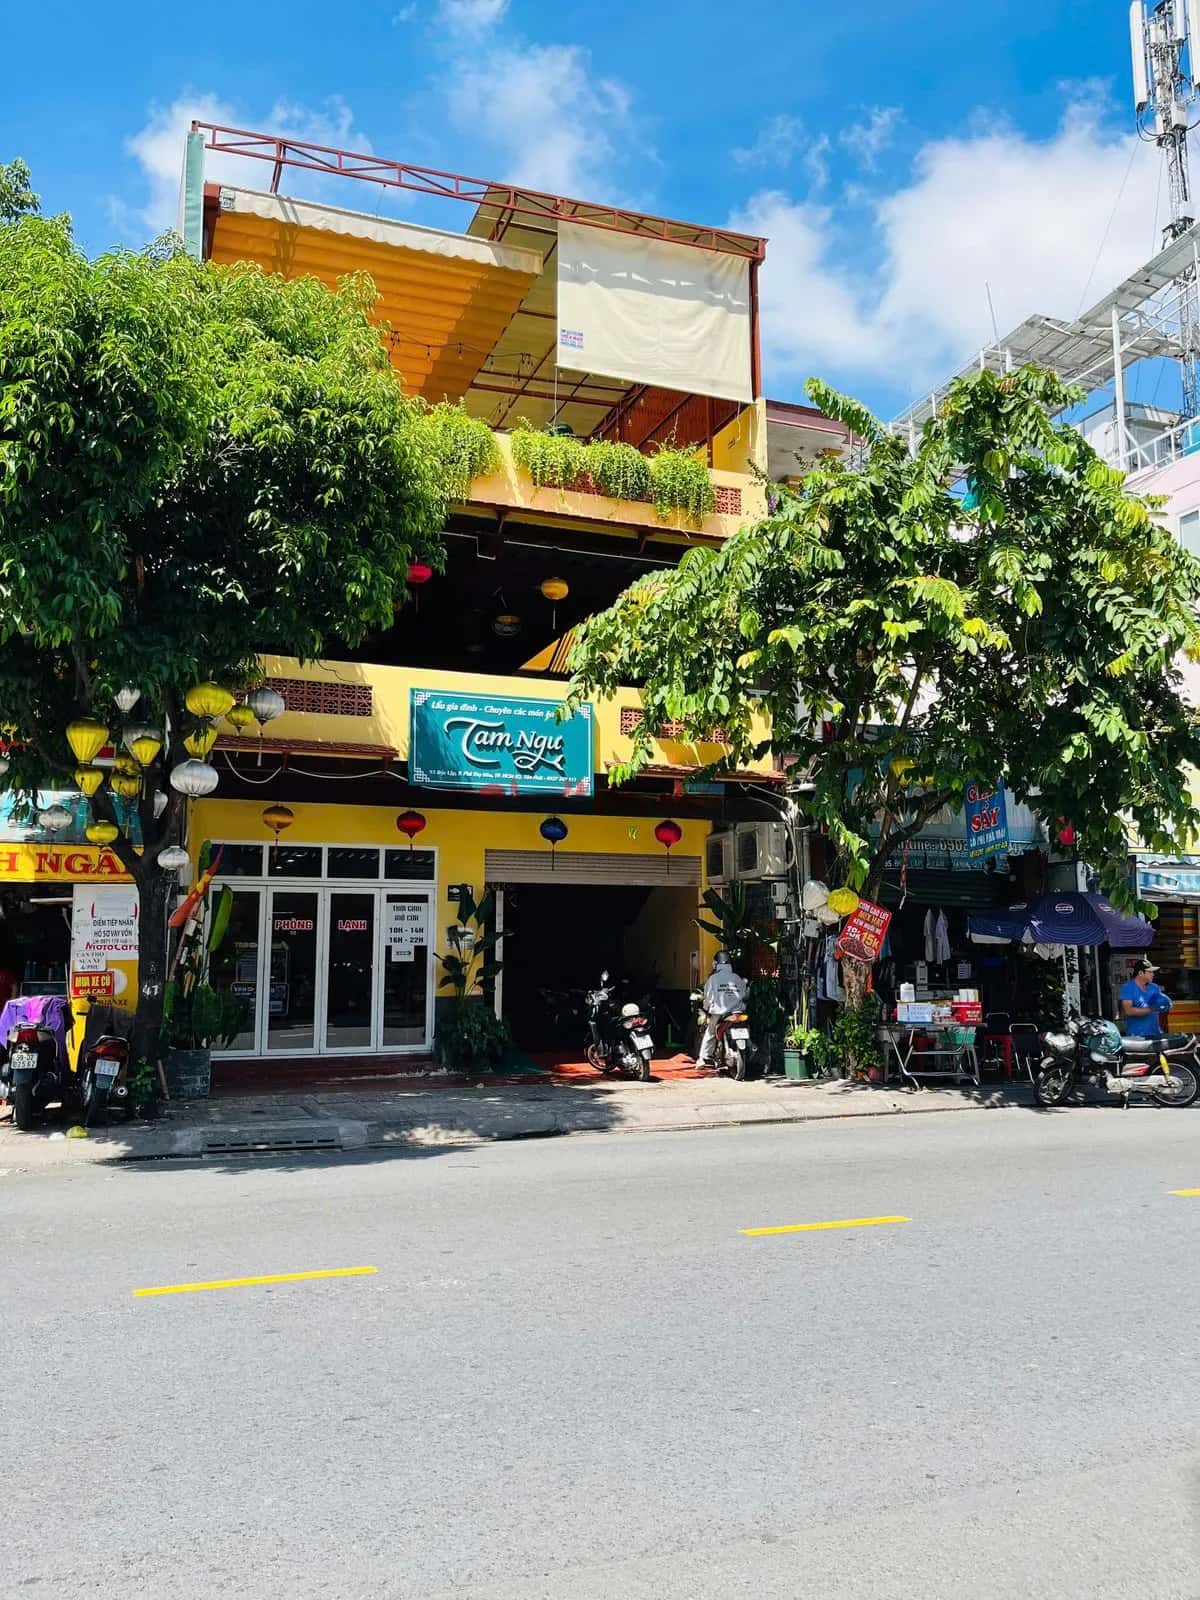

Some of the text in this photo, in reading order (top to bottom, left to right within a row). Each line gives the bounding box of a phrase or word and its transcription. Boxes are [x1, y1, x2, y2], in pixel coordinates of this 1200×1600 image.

[446, 702, 458, 712] gia
[484, 705, 513, 716] Chuyên
[528, 708, 544, 718] món
[444, 717, 513, 763] Tam
[274, 917, 313, 930] PHÒNG
[338, 919, 367, 932] LẠNH
[91, 976, 99, 986] XE
